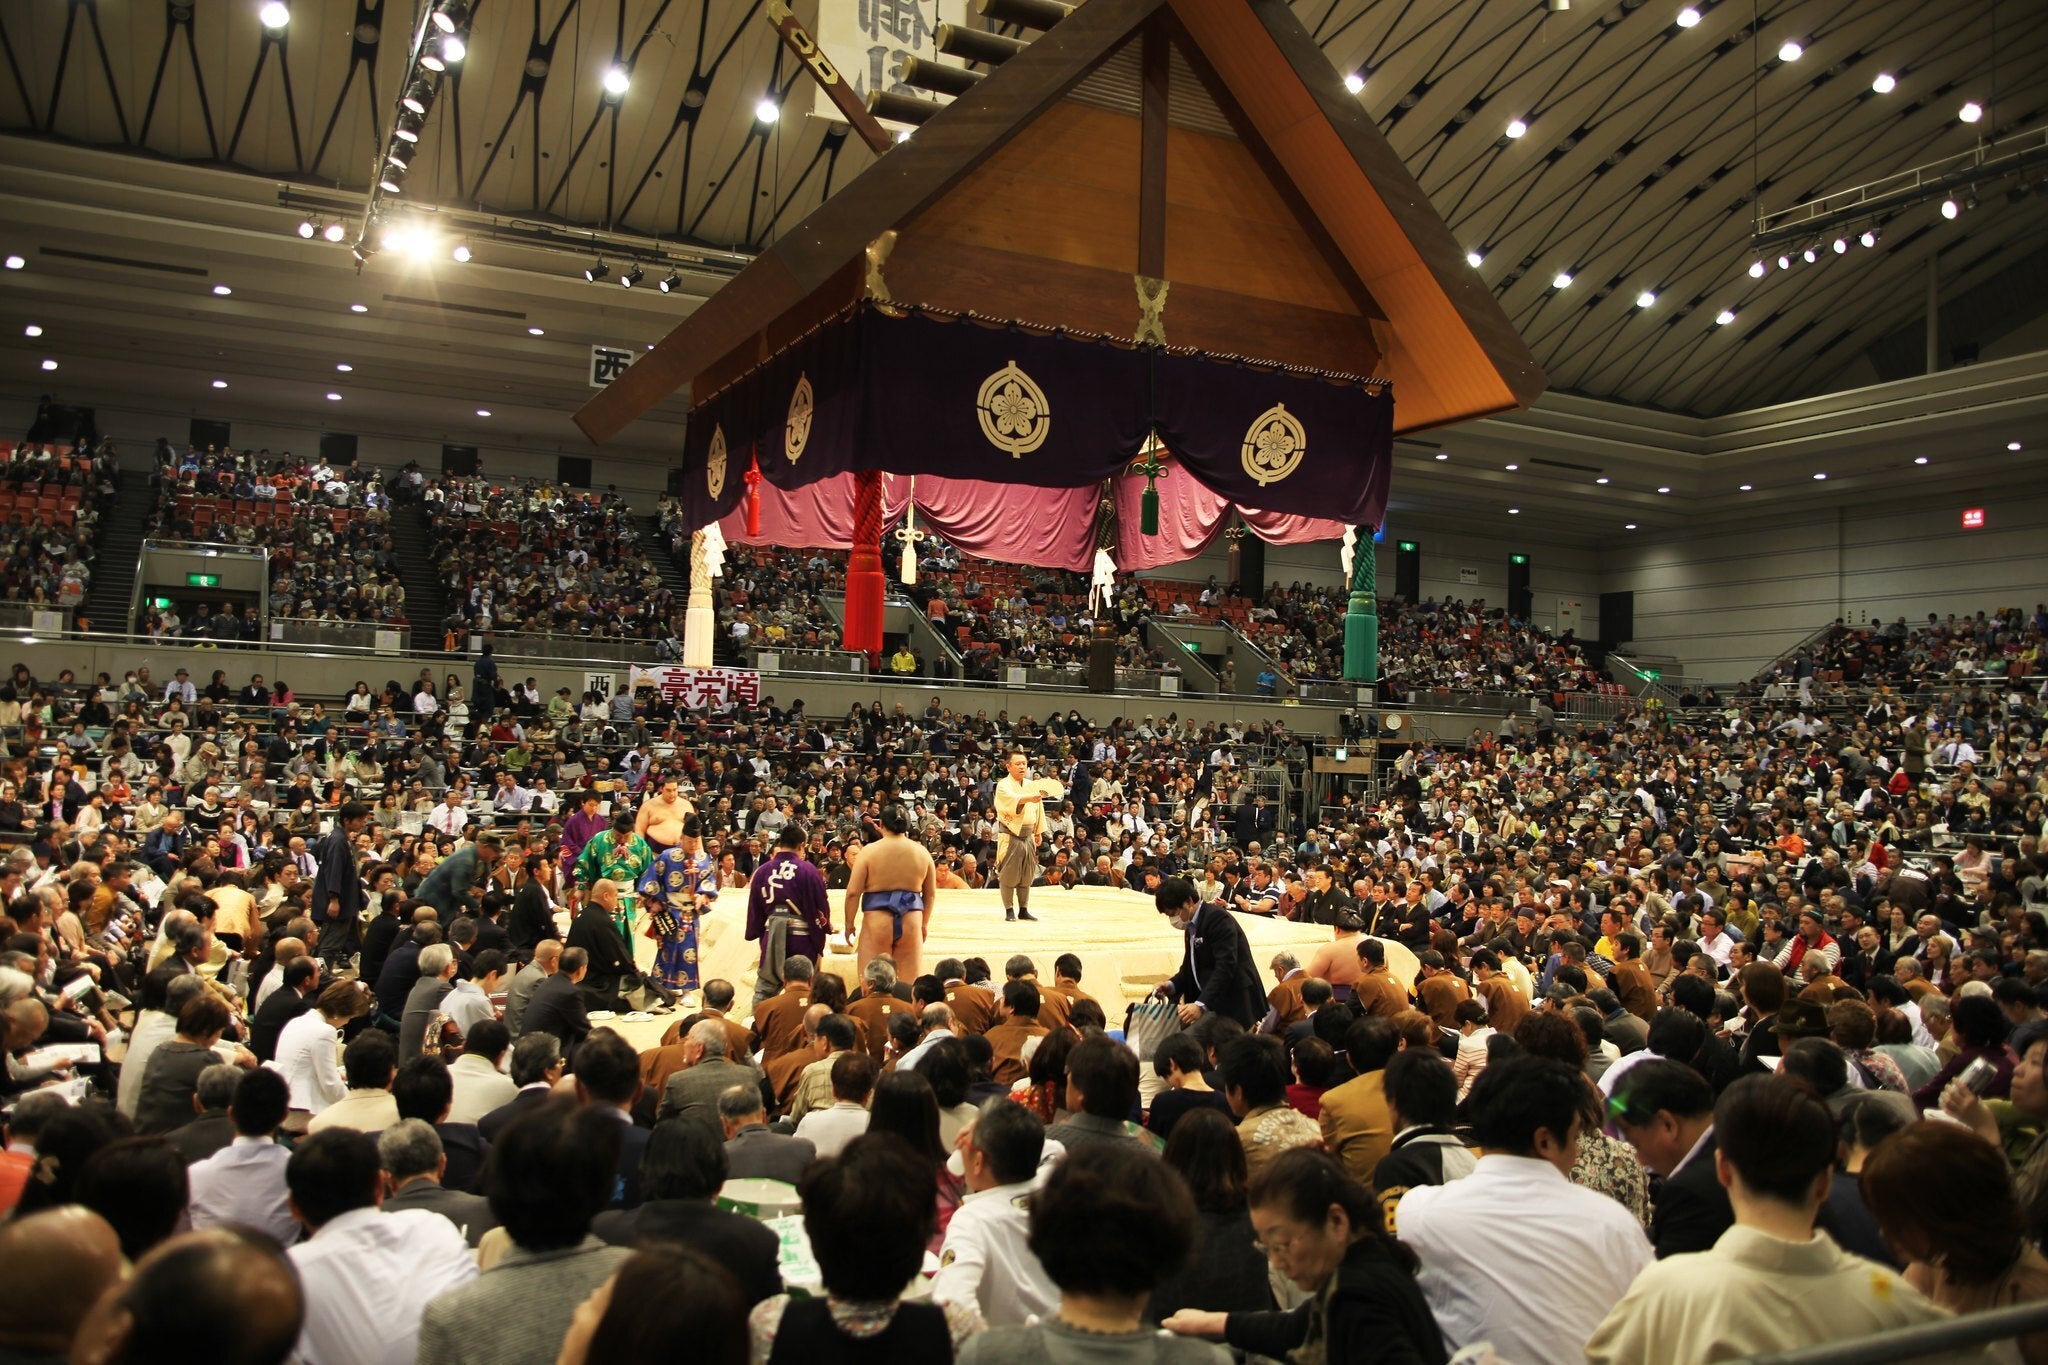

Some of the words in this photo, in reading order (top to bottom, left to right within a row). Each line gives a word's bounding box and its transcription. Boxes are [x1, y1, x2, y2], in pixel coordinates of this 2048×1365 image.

[594, 349, 631, 385] 西
[590, 675, 610, 697] 西
[661, 668, 759, 712] 豪栄道
[761, 860, 798, 904] なとり
